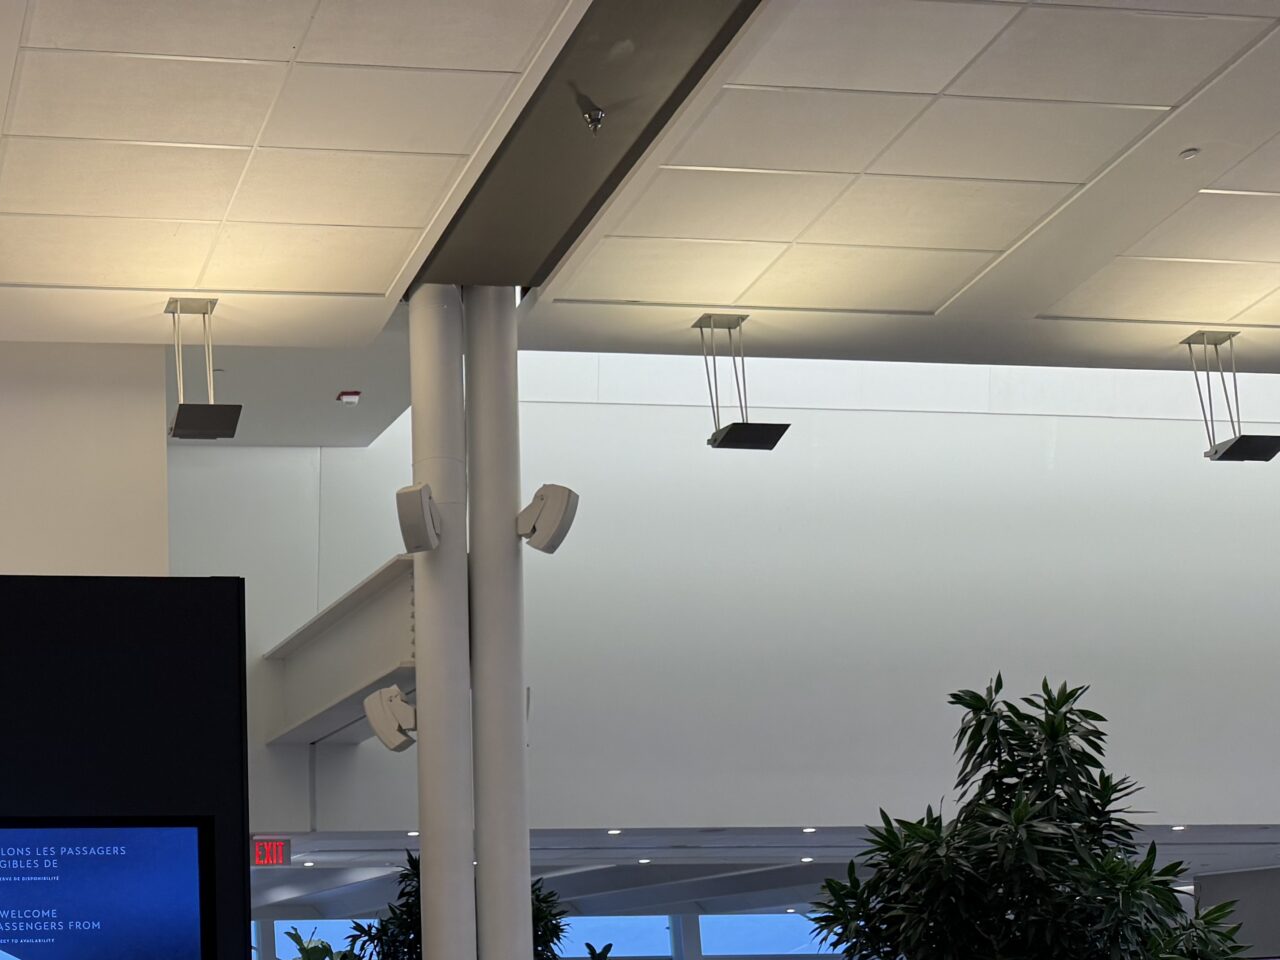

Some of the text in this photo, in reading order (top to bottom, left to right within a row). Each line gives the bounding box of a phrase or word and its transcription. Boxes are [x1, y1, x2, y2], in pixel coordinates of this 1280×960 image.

[36, 846, 56, 856] LES
[60, 846, 126, 855] PASSAGERS
[255, 841, 284, 864] EXIT
[44, 859, 58, 868] DE
[0, 909, 57, 918] WELCOME
[68, 920, 101, 930] FROM
